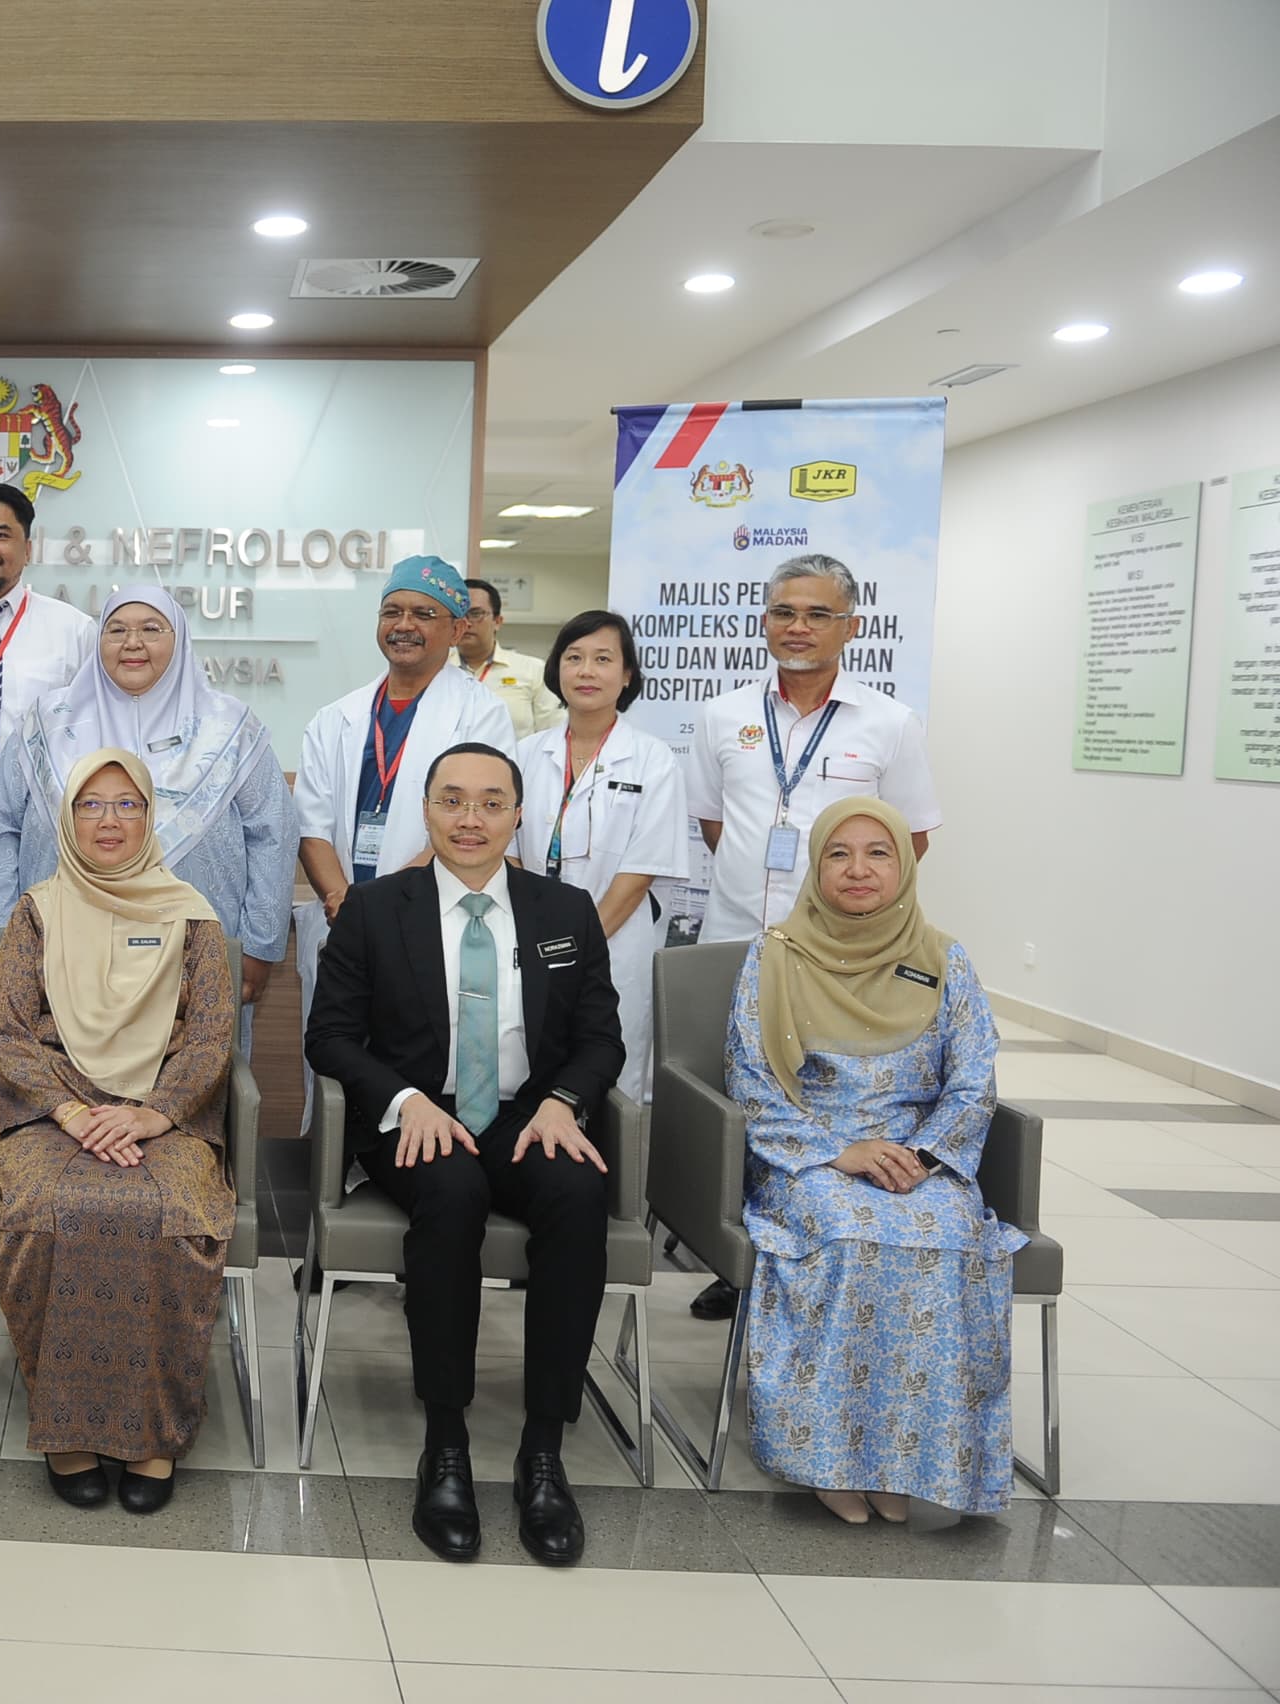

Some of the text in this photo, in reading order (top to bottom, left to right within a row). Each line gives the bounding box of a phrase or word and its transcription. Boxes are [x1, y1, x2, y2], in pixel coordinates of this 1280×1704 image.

[812, 469, 847, 480] JKR
[753, 528, 808, 536] MALAYSIA
[63, 526, 92, 564] &
[112, 528, 387, 571] NEFROLOGI
[753, 536, 808, 546] MADANI
[659, 582, 730, 606] MAJLIS
[631, 614, 739, 638] KOMPLEKS
[676, 646, 716, 670] DAN
[724, 647, 768, 671] WAD
[680, 723, 695, 734] 25
